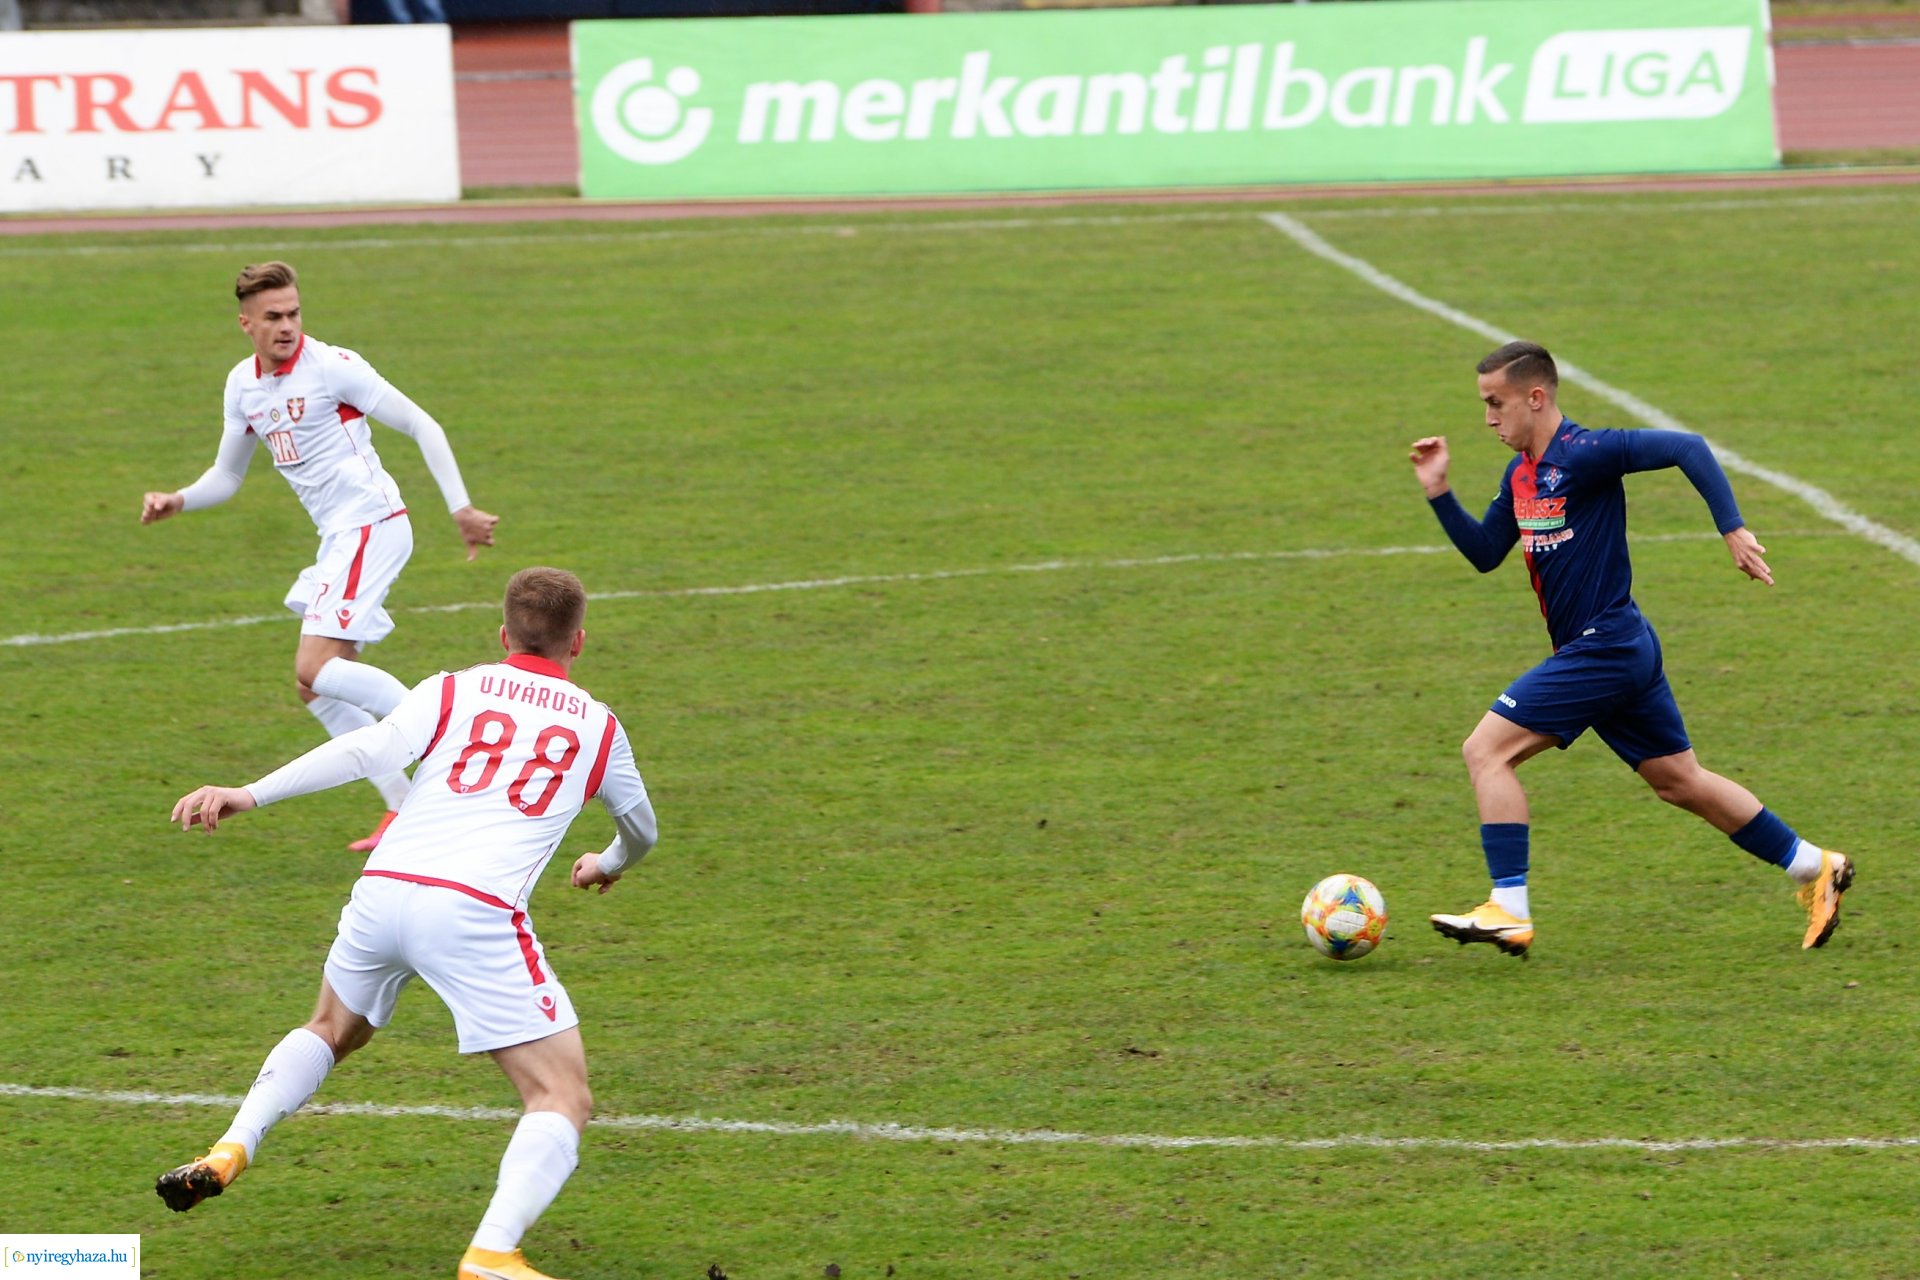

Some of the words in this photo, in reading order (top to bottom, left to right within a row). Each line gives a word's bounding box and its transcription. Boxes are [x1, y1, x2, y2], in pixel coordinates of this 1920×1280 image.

[0, 66, 383, 133] TRANS
[1555, 50, 1726, 99] LIGA
[480, 676, 587, 720] UJVÁROSI
[446, 709, 581, 817] 88
